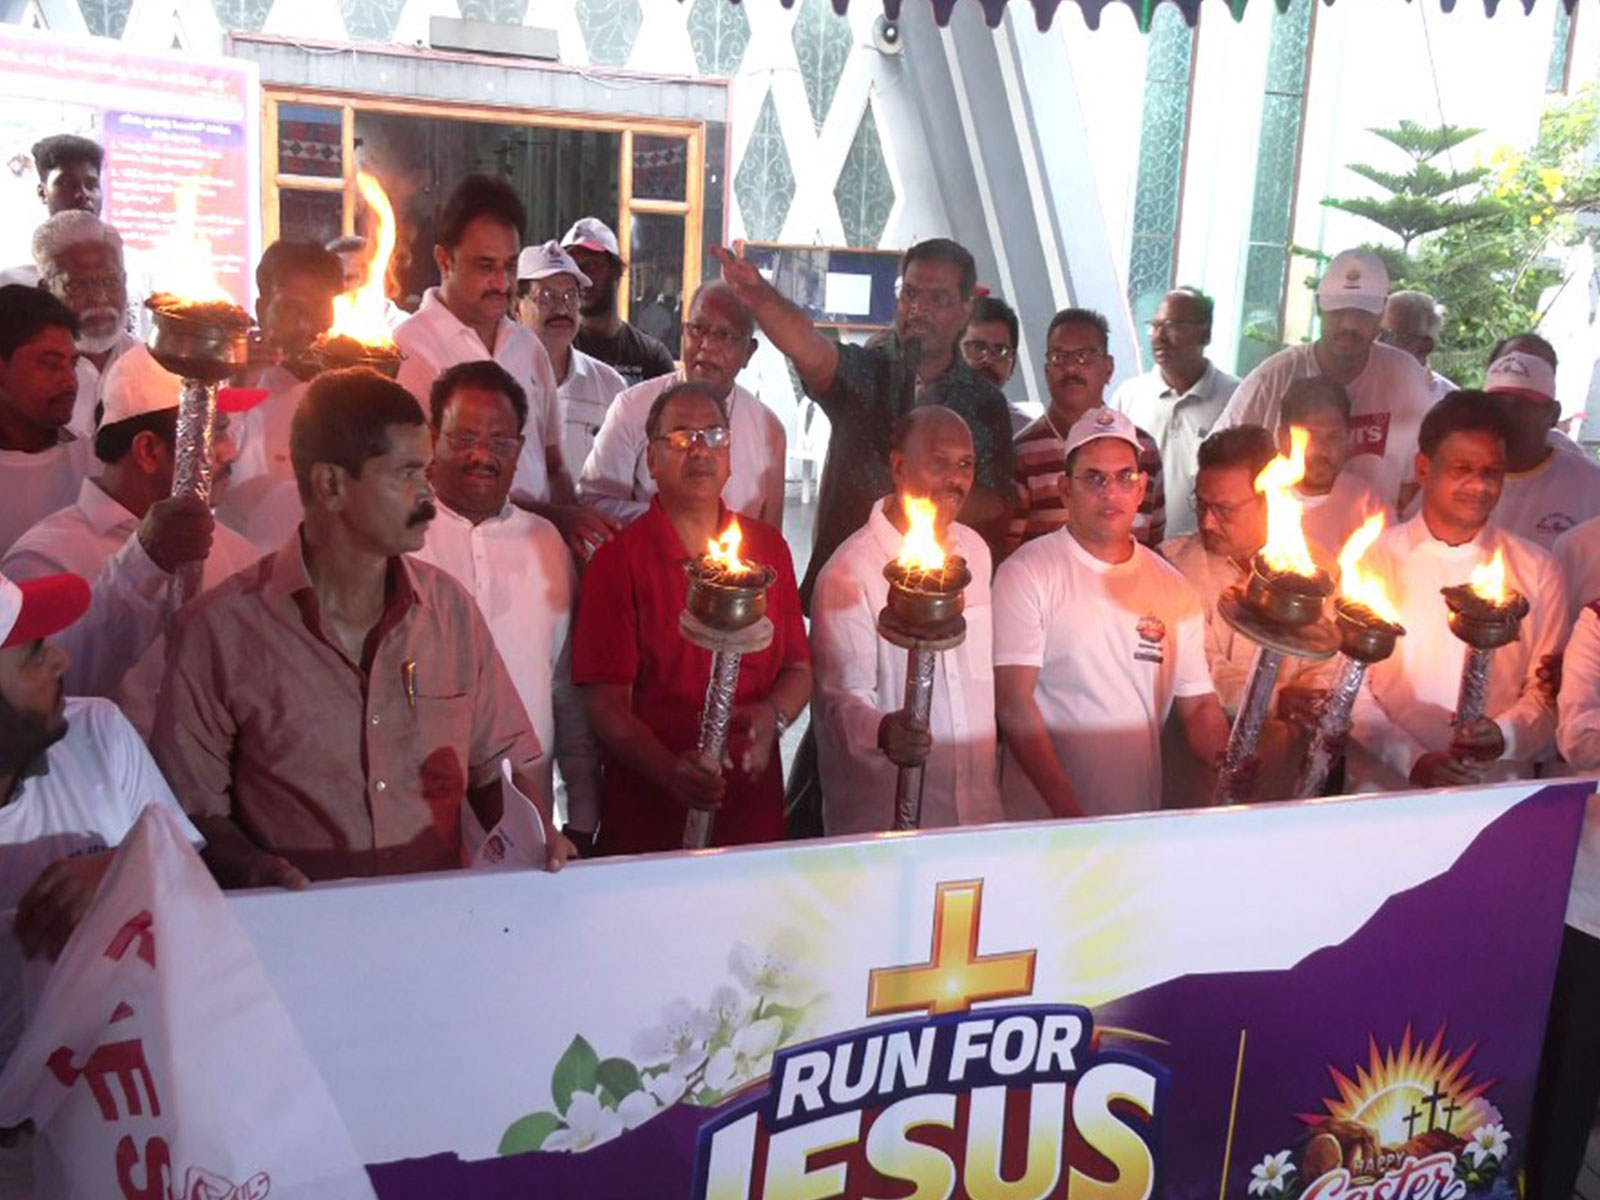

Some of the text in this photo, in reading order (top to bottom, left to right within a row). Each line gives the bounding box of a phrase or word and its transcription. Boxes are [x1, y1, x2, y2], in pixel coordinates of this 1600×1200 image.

[776, 1015, 1082, 1120] RUN FOR
[1353, 1151, 1405, 1174] HAPPY
